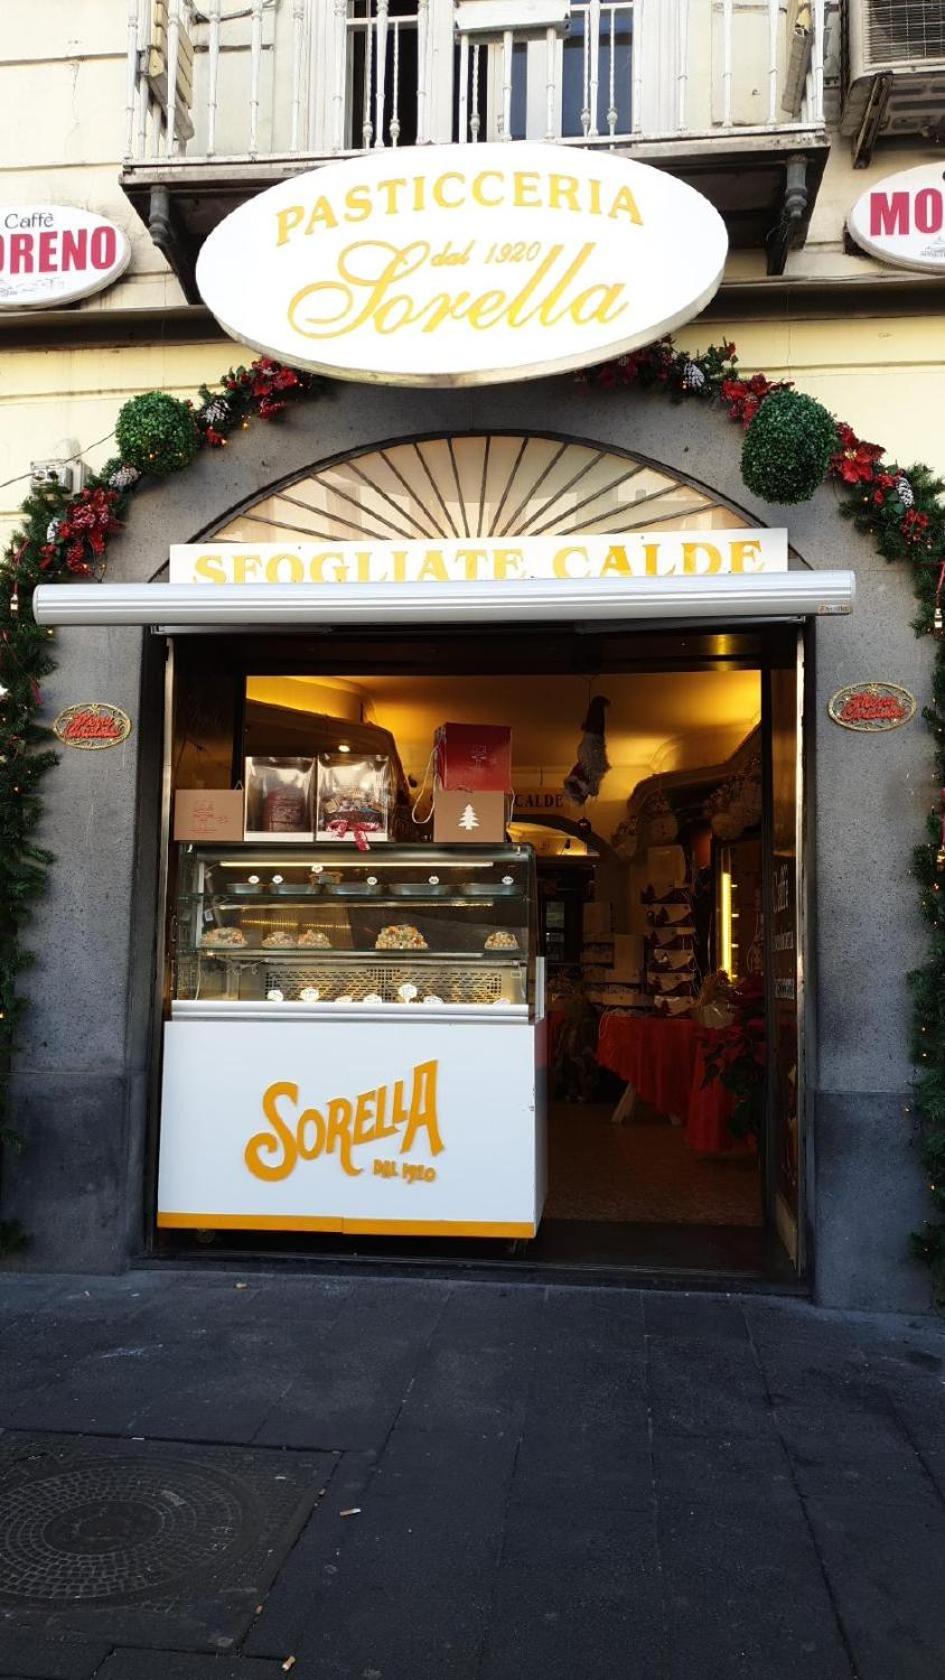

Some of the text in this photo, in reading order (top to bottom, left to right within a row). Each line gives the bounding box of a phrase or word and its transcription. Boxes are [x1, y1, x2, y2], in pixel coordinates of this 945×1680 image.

[4, 212, 54, 229] Caffè
[276, 171, 644, 247] PASTICCERIA
[431, 240, 541, 267] dal 1920
[287, 240, 630, 340] Sorella
[193, 539, 765, 585] SFOGLIATE CALDE
[513, 793, 564, 808] CALDE
[244, 1059, 446, 1182] SORELLA
